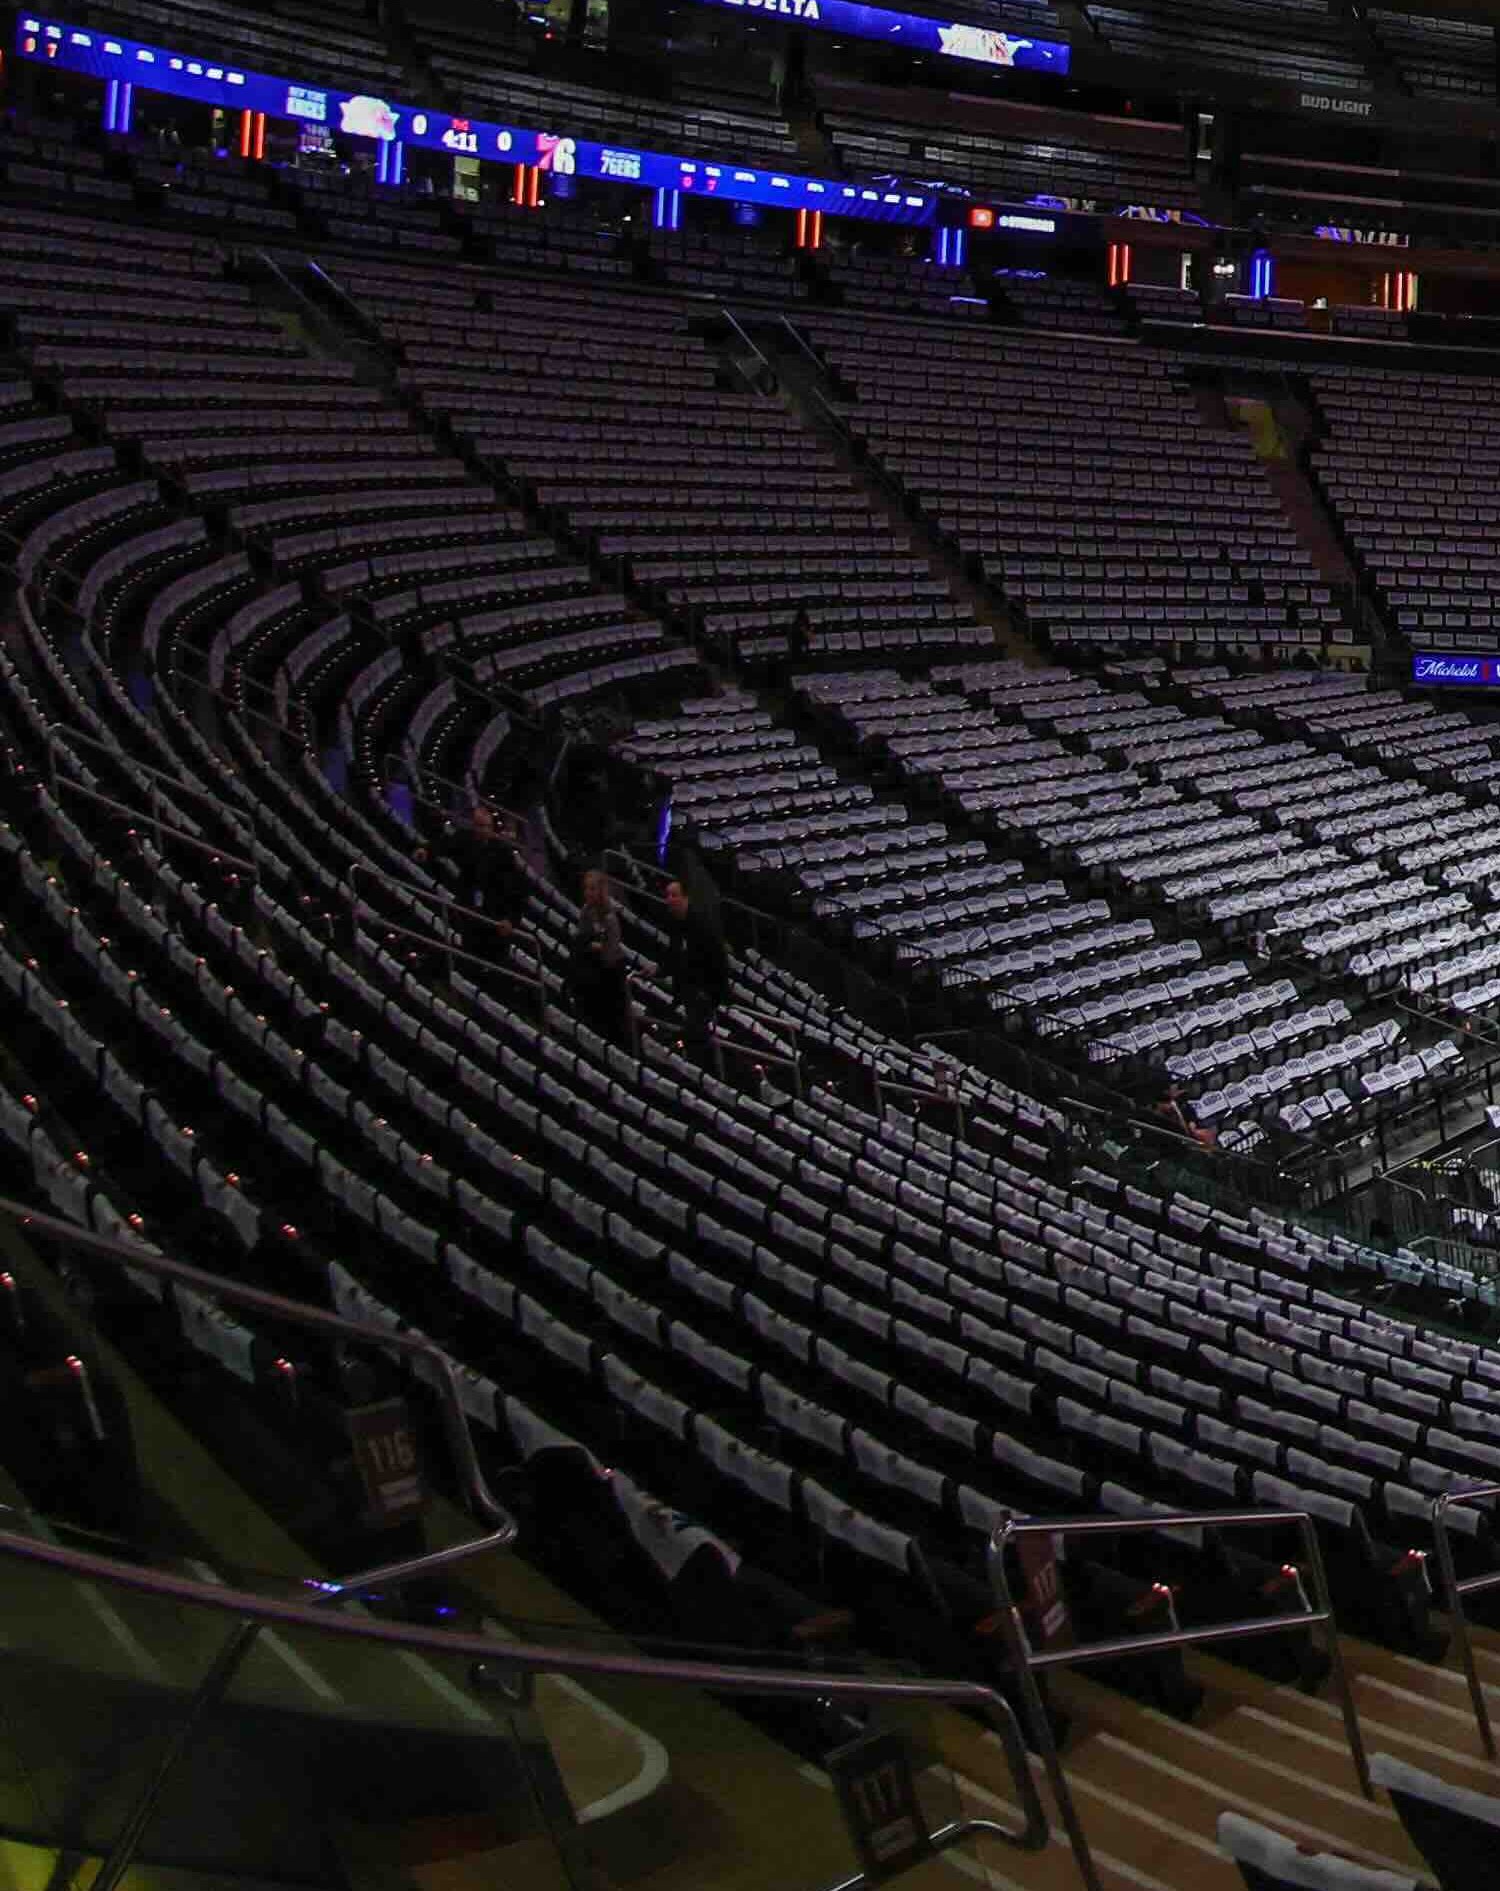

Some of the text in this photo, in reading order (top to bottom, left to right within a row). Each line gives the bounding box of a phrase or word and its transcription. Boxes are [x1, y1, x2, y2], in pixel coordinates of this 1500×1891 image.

[1301, 93, 1373, 116] BUD LIGHT
[411, 113, 428, 136] 0
[441, 128, 479, 154] 4:11
[496, 130, 513, 153] 0
[535, 131, 577, 176] 76
[600, 156, 642, 180] 76ERS
[1416, 659, 1479, 678] Michelob
